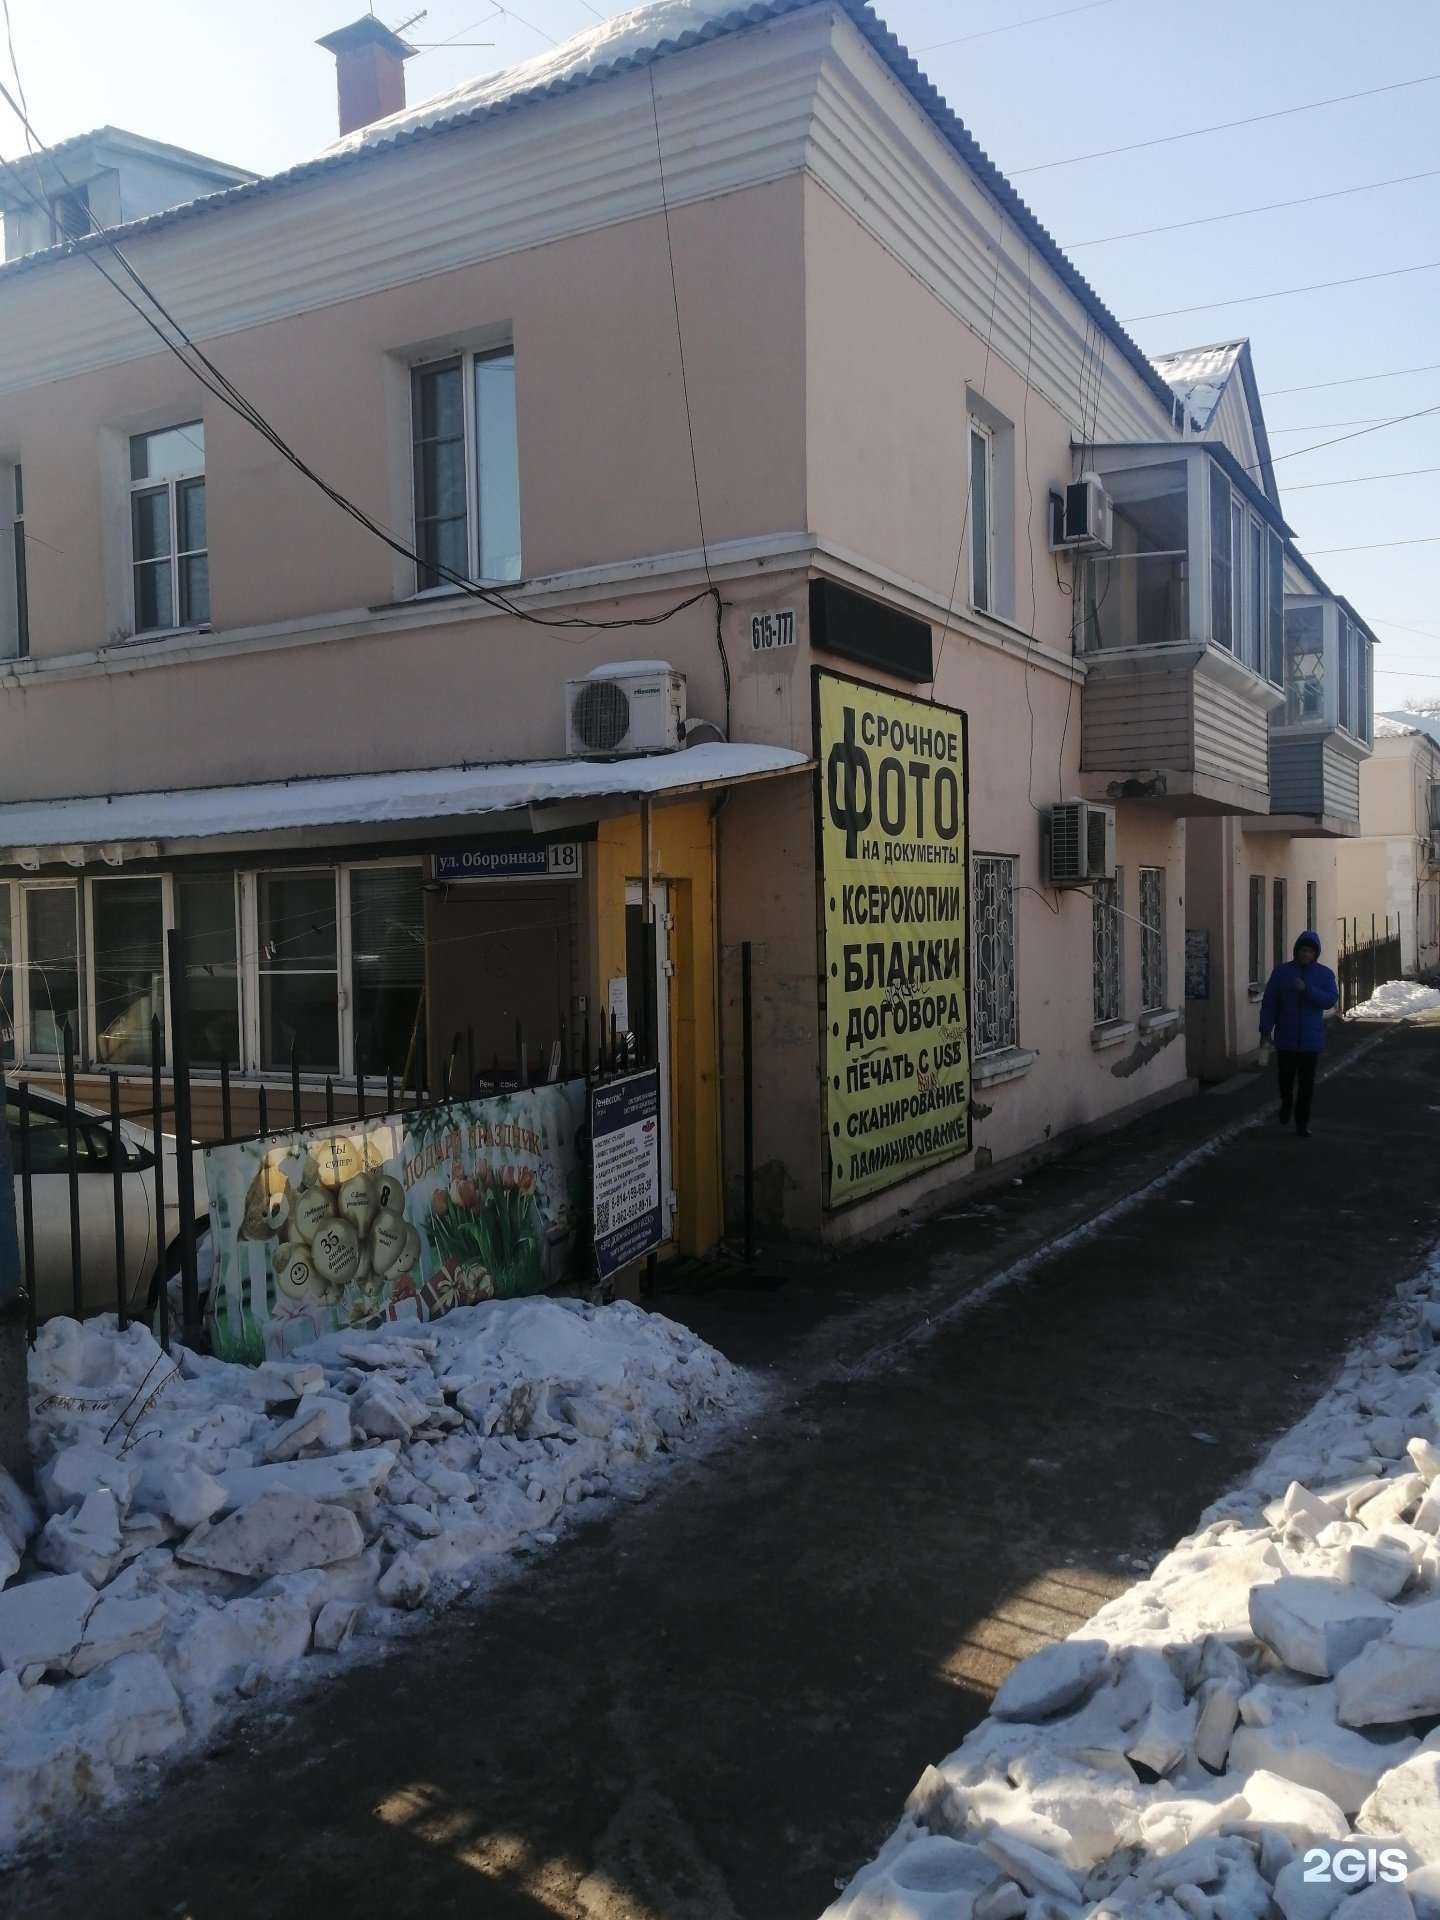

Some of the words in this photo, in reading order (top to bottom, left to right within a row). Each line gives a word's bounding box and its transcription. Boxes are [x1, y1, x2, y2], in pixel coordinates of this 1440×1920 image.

[752, 611, 793, 650] 615-777
[861, 711, 958, 763] СРОЧНОЕ
[828, 706, 959, 859] ФОТО
[440, 855, 459, 872] ул.
[462, 851, 545, 870] Оборонная
[551, 846, 575, 866] 18
[863, 840, 880, 860] НА
[885, 841, 959, 865] ДОКУМЕНТЫ
[843, 937, 960, 992] БЛАНКИ
[846, 992, 961, 1051] ДОГОВОРА
[846, 1053, 914, 1094] ПЕЧАТЬ
[918, 1048, 930, 1075] С
[933, 1041, 962, 1070] USB
[846, 1080, 966, 1138] СКАНИРОВАНИЕ
[328, 1144, 346, 1154] ТЫ
[404, 1128, 461, 1192] ПОДАРИ
[468, 1124, 542, 1157] ПРАЗДНИК
[849, 1118, 966, 1182] ЛАМИНИРОВАНИЕ
[380, 1185, 391, 1207] 8
[321, 1231, 340, 1254] 35
